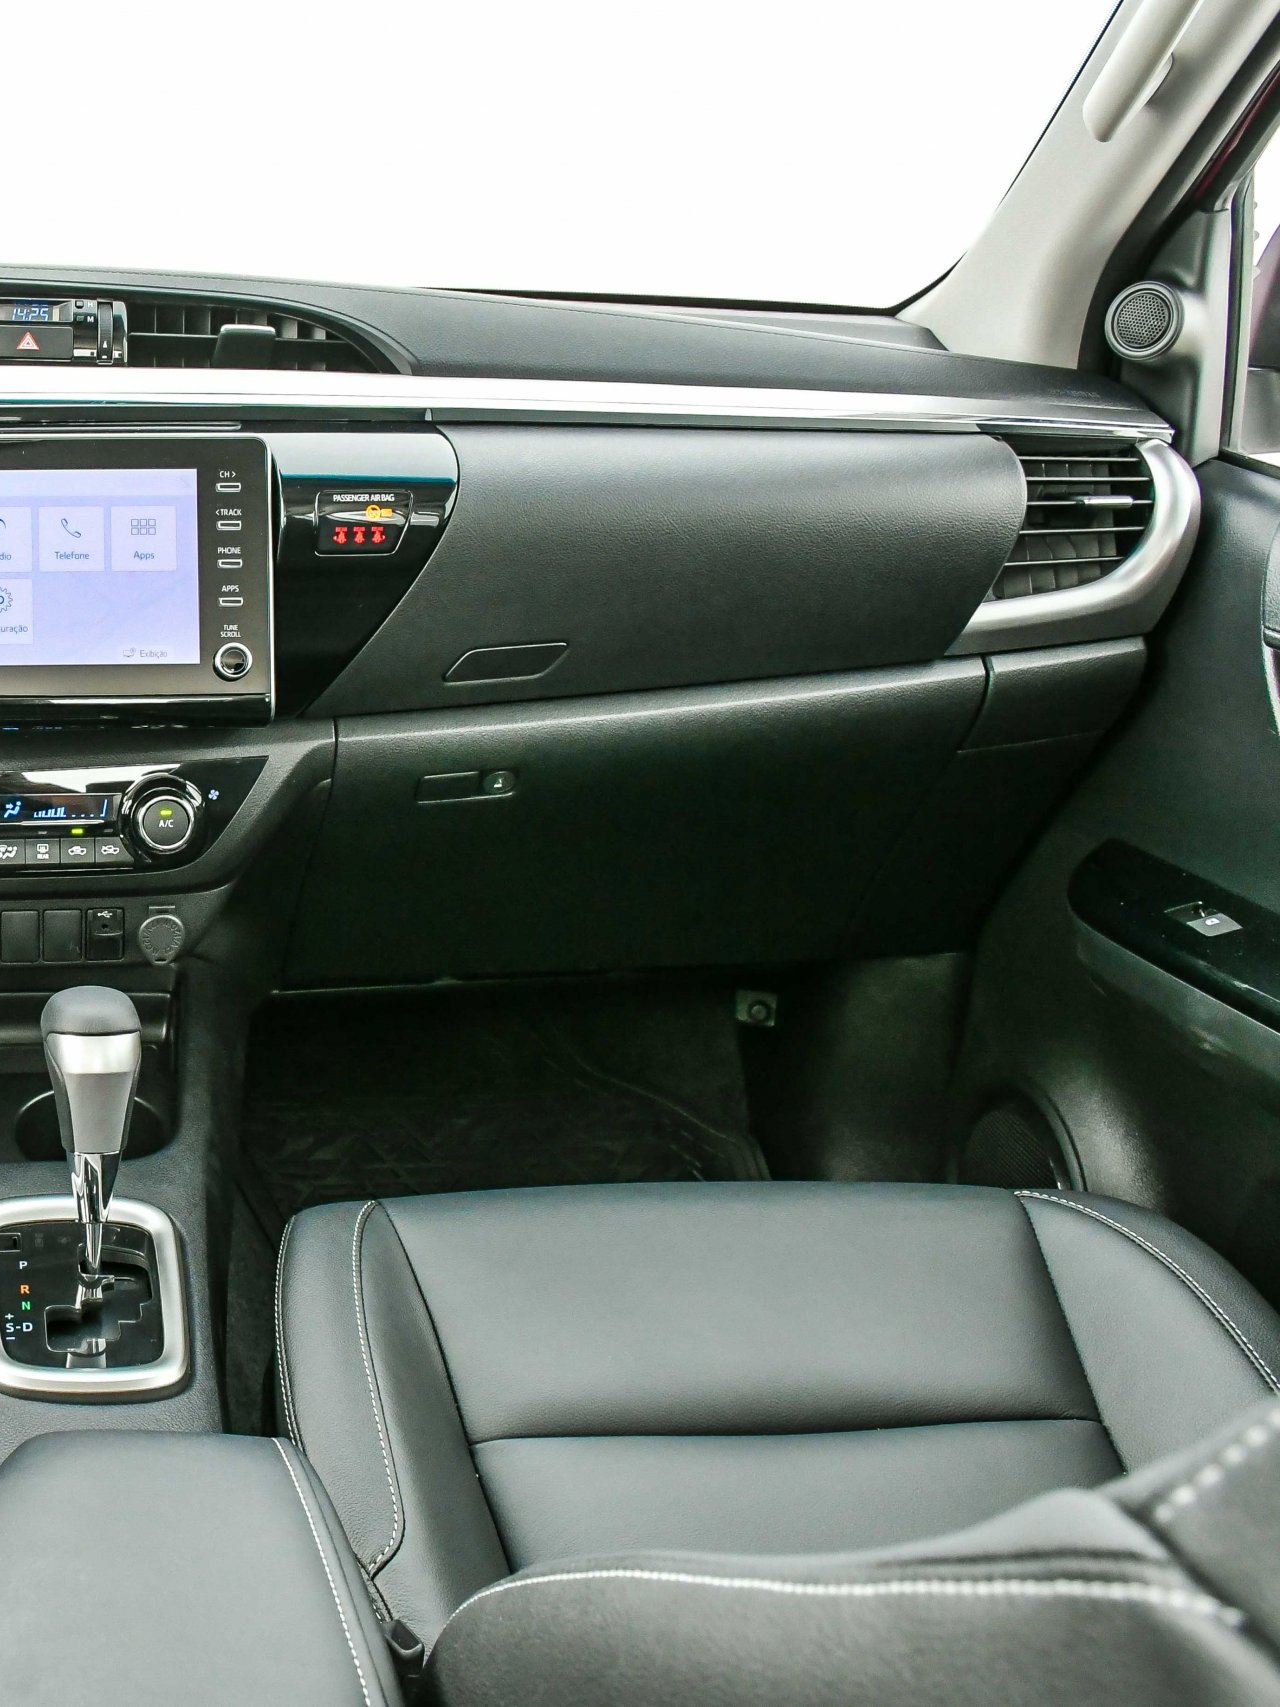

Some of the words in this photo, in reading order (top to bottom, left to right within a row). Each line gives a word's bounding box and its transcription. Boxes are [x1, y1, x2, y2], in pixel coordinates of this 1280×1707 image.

[12, 308, 49, 321] 14:25
[332, 493, 370, 502] PASSENGER
[54, 551, 90, 560] Telefone
[217, 547, 242, 555] PHONE
[133, 550, 155, 562] Apps
[221, 585, 239, 593] APPS
[139, 648, 168, 659] Exibição
[158, 819, 174, 828] A/C
[19, 1260, 28, 1270] P
[20, 1284, 30, 1294] R
[21, 1301, 31, 1310] N
